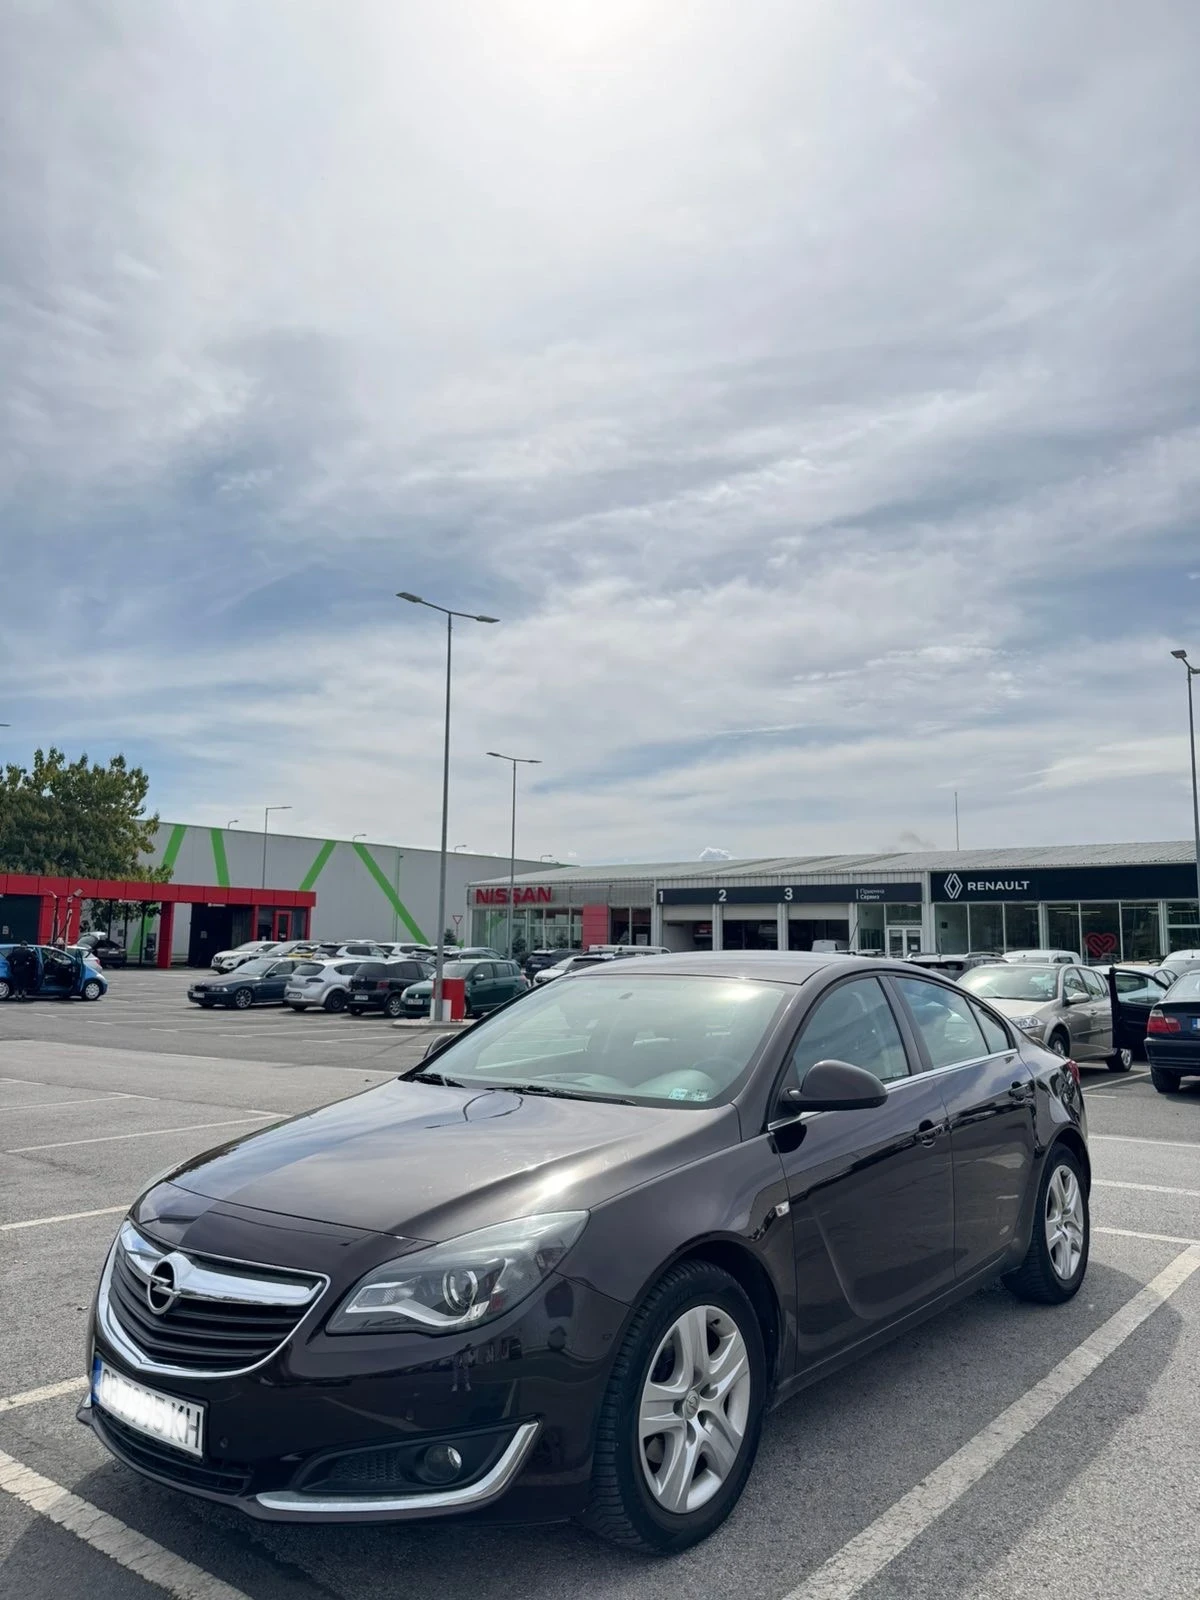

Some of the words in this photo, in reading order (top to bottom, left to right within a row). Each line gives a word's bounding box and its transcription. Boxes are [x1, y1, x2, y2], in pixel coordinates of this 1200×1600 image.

[967, 881, 1030, 891] RENAULT
[476, 887, 552, 904] NISSAN
[659, 890, 664, 903] 1
[718, 889, 727, 902] 2
[784, 887, 793, 900] 3
